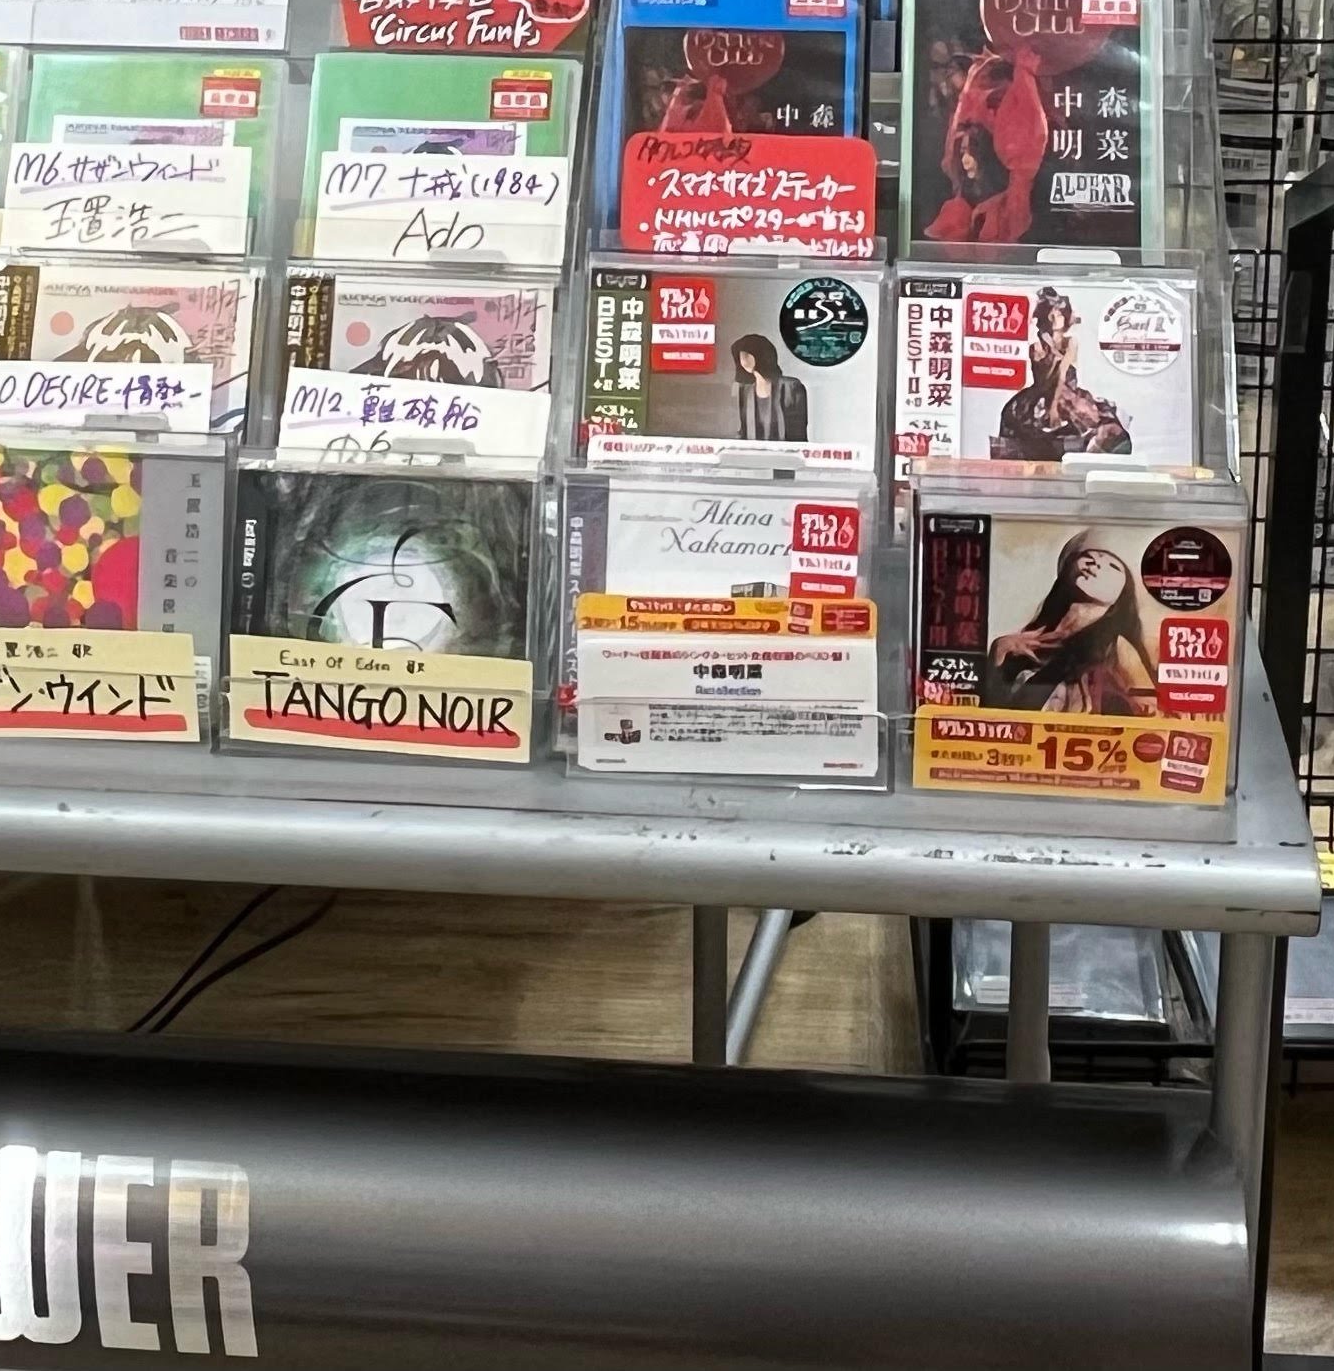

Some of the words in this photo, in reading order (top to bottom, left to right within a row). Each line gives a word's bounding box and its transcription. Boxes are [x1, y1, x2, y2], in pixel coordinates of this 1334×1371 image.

[1053, 85, 1130, 118] 中森
[1052, 128, 1130, 162] 明菜
[42, 194, 200, 242] 玉置浩二
[392, 207, 485, 258] Ado
[689, 498, 774, 528] Akina
[252, 670, 407, 730] TANGO
[418, 691, 520, 737] NOIR
[1036, 736, 1128, 773] 15%
